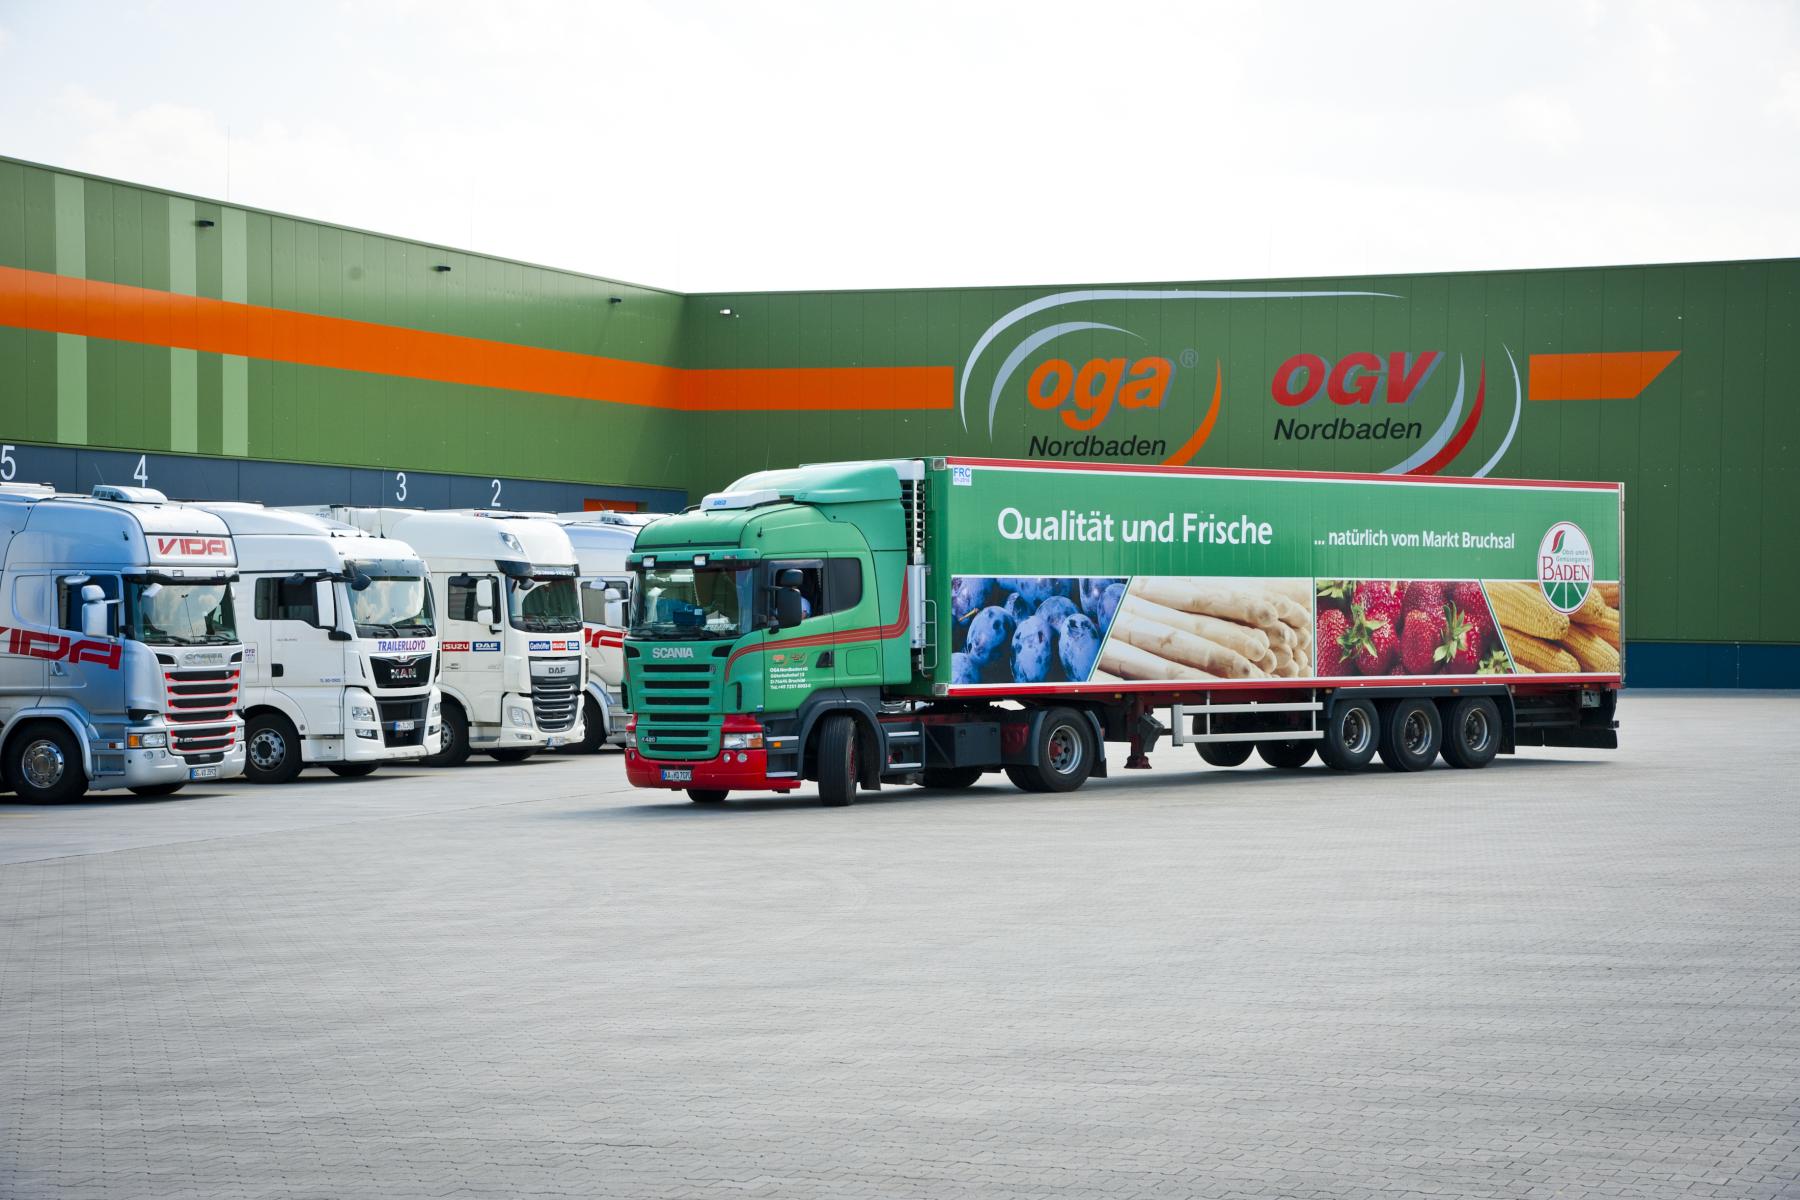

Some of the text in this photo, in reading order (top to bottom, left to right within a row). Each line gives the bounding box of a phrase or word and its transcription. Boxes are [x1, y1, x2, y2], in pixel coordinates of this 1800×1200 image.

[1271, 351, 1445, 408] OGV
[1027, 355, 1175, 431] oga
[1274, 417, 1422, 441] Nordbaden
[1028, 434, 1167, 457] Nordbaden
[0, 446, 16, 481] 5
[133, 454, 149, 487] 4
[953, 467, 971, 478] FRC
[396, 472, 407, 501] 3
[491, 479, 502, 507] 2
[997, 507, 1273, 545] Qualität und Frische
[157, 537, 227, 556] VIDA
[1328, 528, 1389, 547] natürlich
[1391, 533, 1420, 548] vom
[1422, 530, 1460, 548] Markt
[1462, 532, 1515, 549] Bruchsal
[377, 639, 427, 652] TRAILERLLOYD
[652, 647, 694, 659] SCANIA
[390, 668, 417, 679] MAN
[548, 666, 566, 675] DAF
